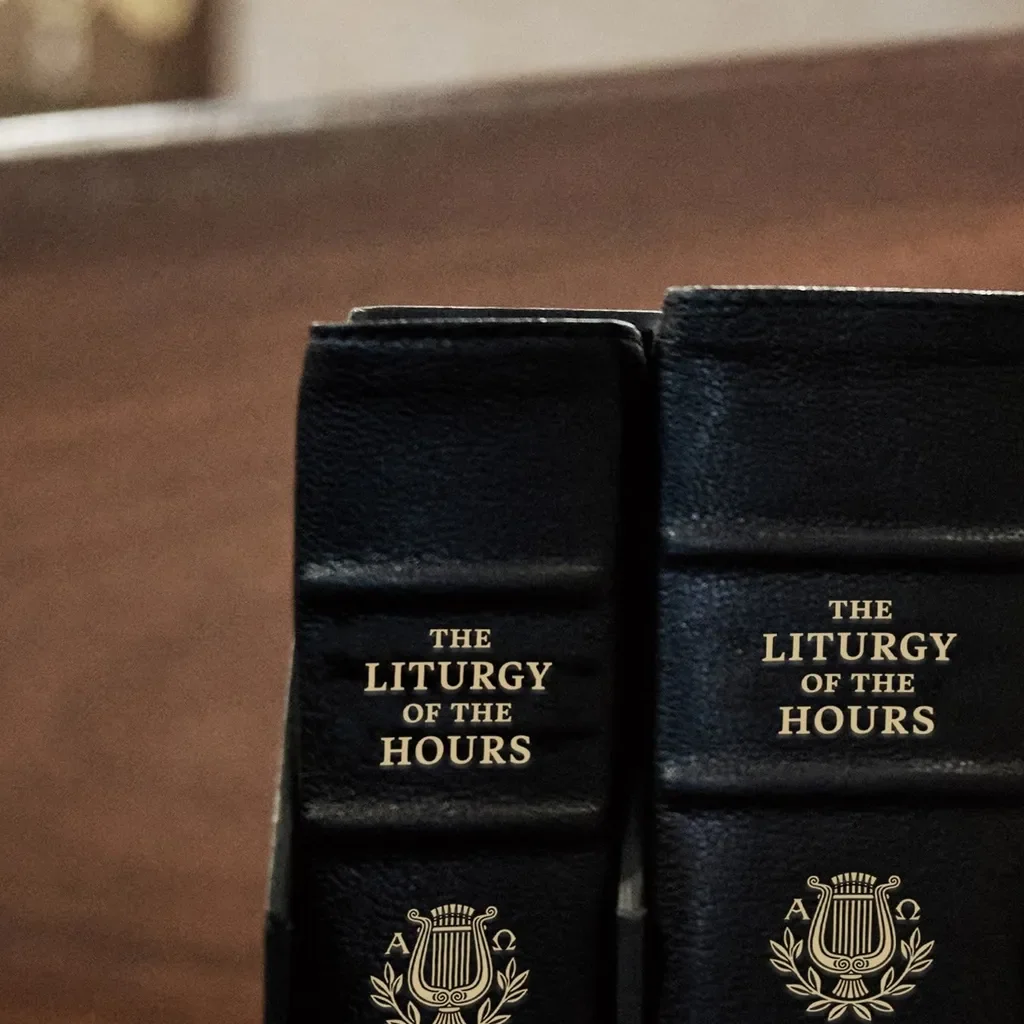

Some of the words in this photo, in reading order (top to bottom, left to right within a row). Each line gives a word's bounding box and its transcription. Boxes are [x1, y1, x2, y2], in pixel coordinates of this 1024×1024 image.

[828, 599, 893, 620] THE
[428, 628, 492, 649] THE
[761, 631, 958, 662] LITURGY
[363, 661, 553, 692] LITURGY
[800, 673, 842, 694] OF
[850, 673, 915, 693] THE
[402, 703, 442, 724] OF
[450, 702, 512, 723] THE
[777, 705, 935, 735] HOURS
[379, 734, 531, 767] HOURS
[895, 898, 921, 921] Ω
[492, 928, 517, 952] Ω
